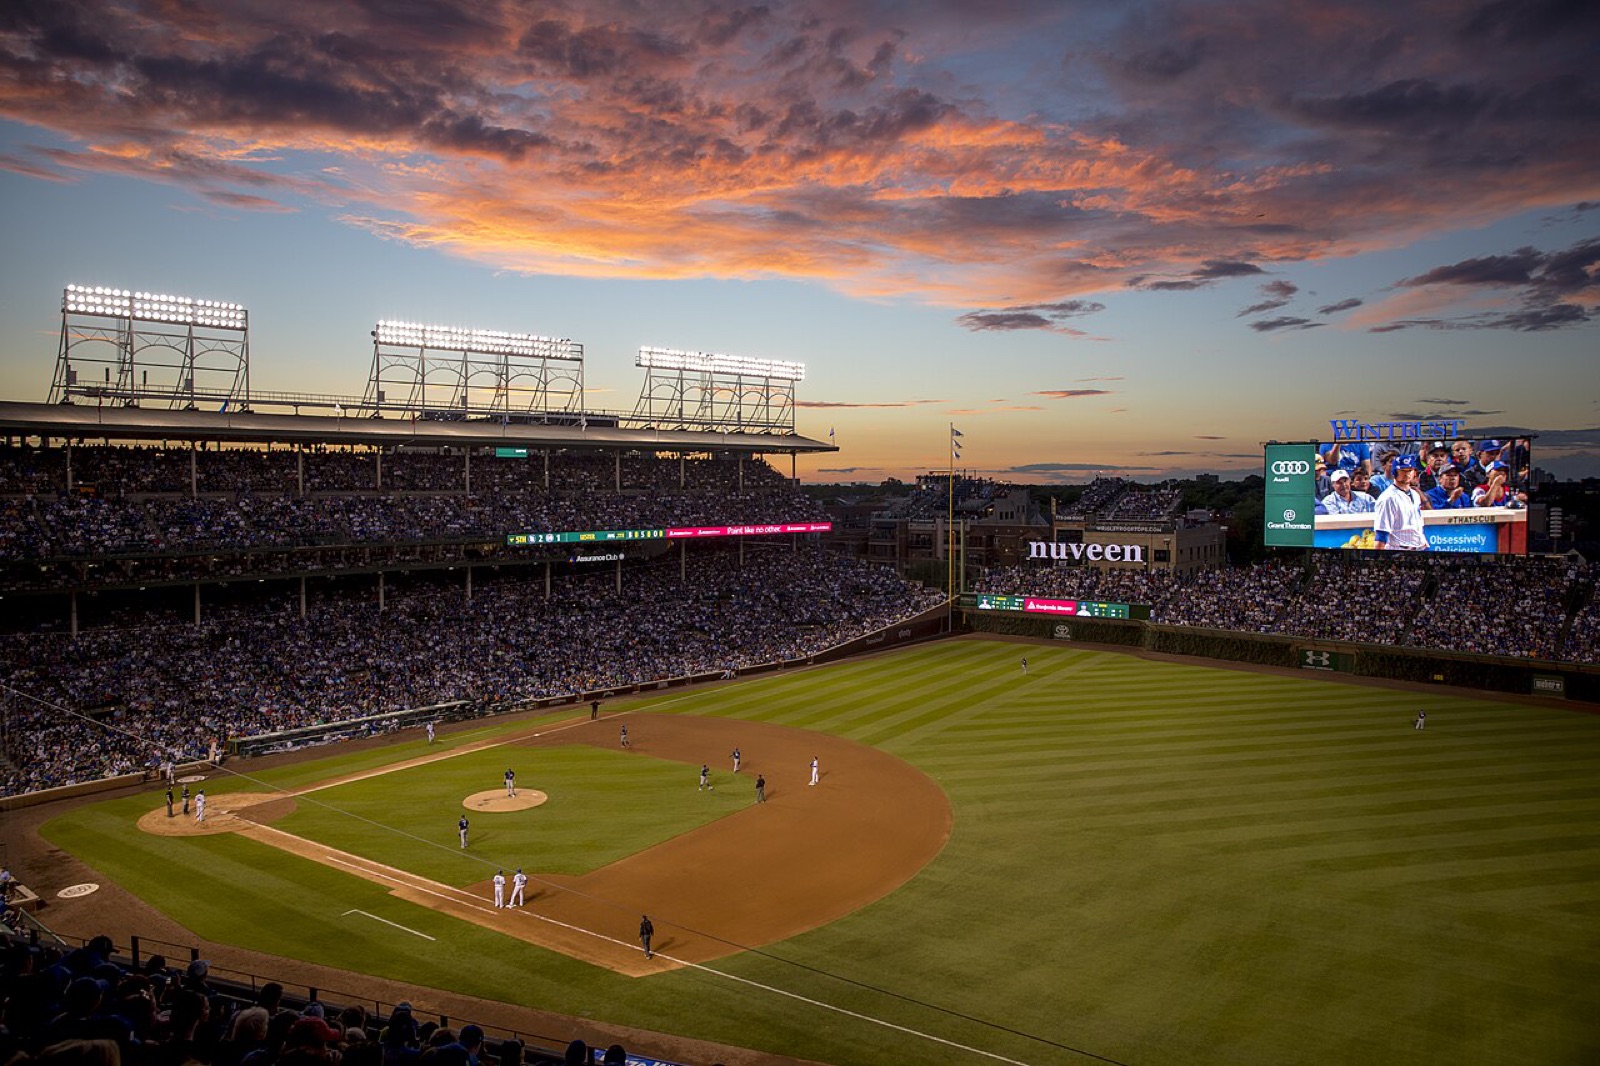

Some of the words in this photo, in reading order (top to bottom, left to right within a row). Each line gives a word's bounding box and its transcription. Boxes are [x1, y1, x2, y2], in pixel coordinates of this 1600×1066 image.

[1329, 419, 1466, 440] WINTRUST
[727, 526, 743, 535] Paint
[1267, 521, 1284, 529] Grant
[1429, 534, 1487, 546] Obsessively
[1029, 540, 1144, 563] nuveen
